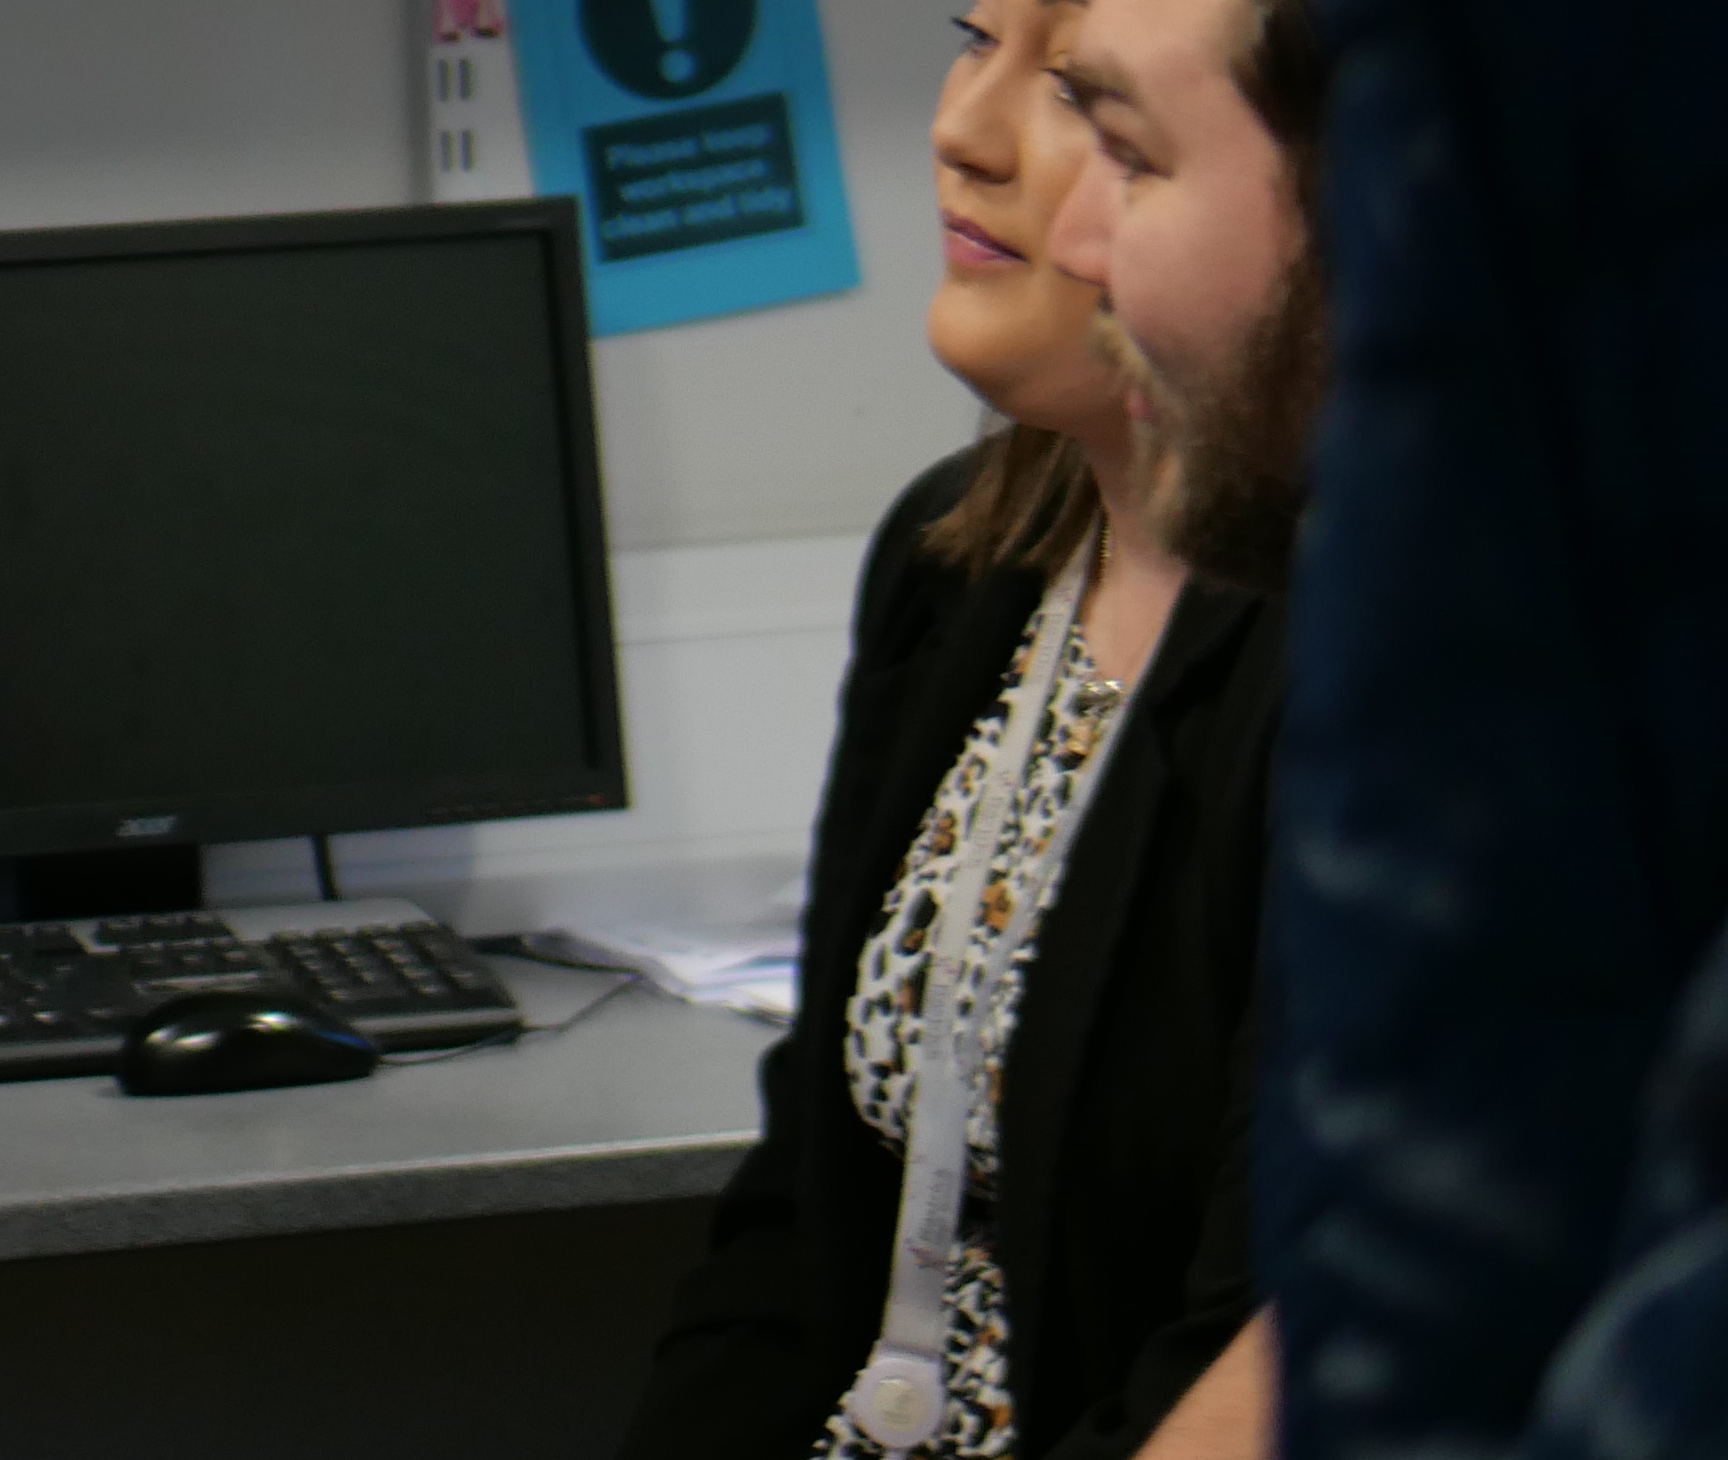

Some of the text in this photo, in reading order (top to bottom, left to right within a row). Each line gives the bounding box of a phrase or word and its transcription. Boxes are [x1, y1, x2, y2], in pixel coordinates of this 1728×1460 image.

[606, 122, 774, 170] Please keep
[619, 157, 771, 203] workspace
[601, 185, 794, 240] clean and tidy
